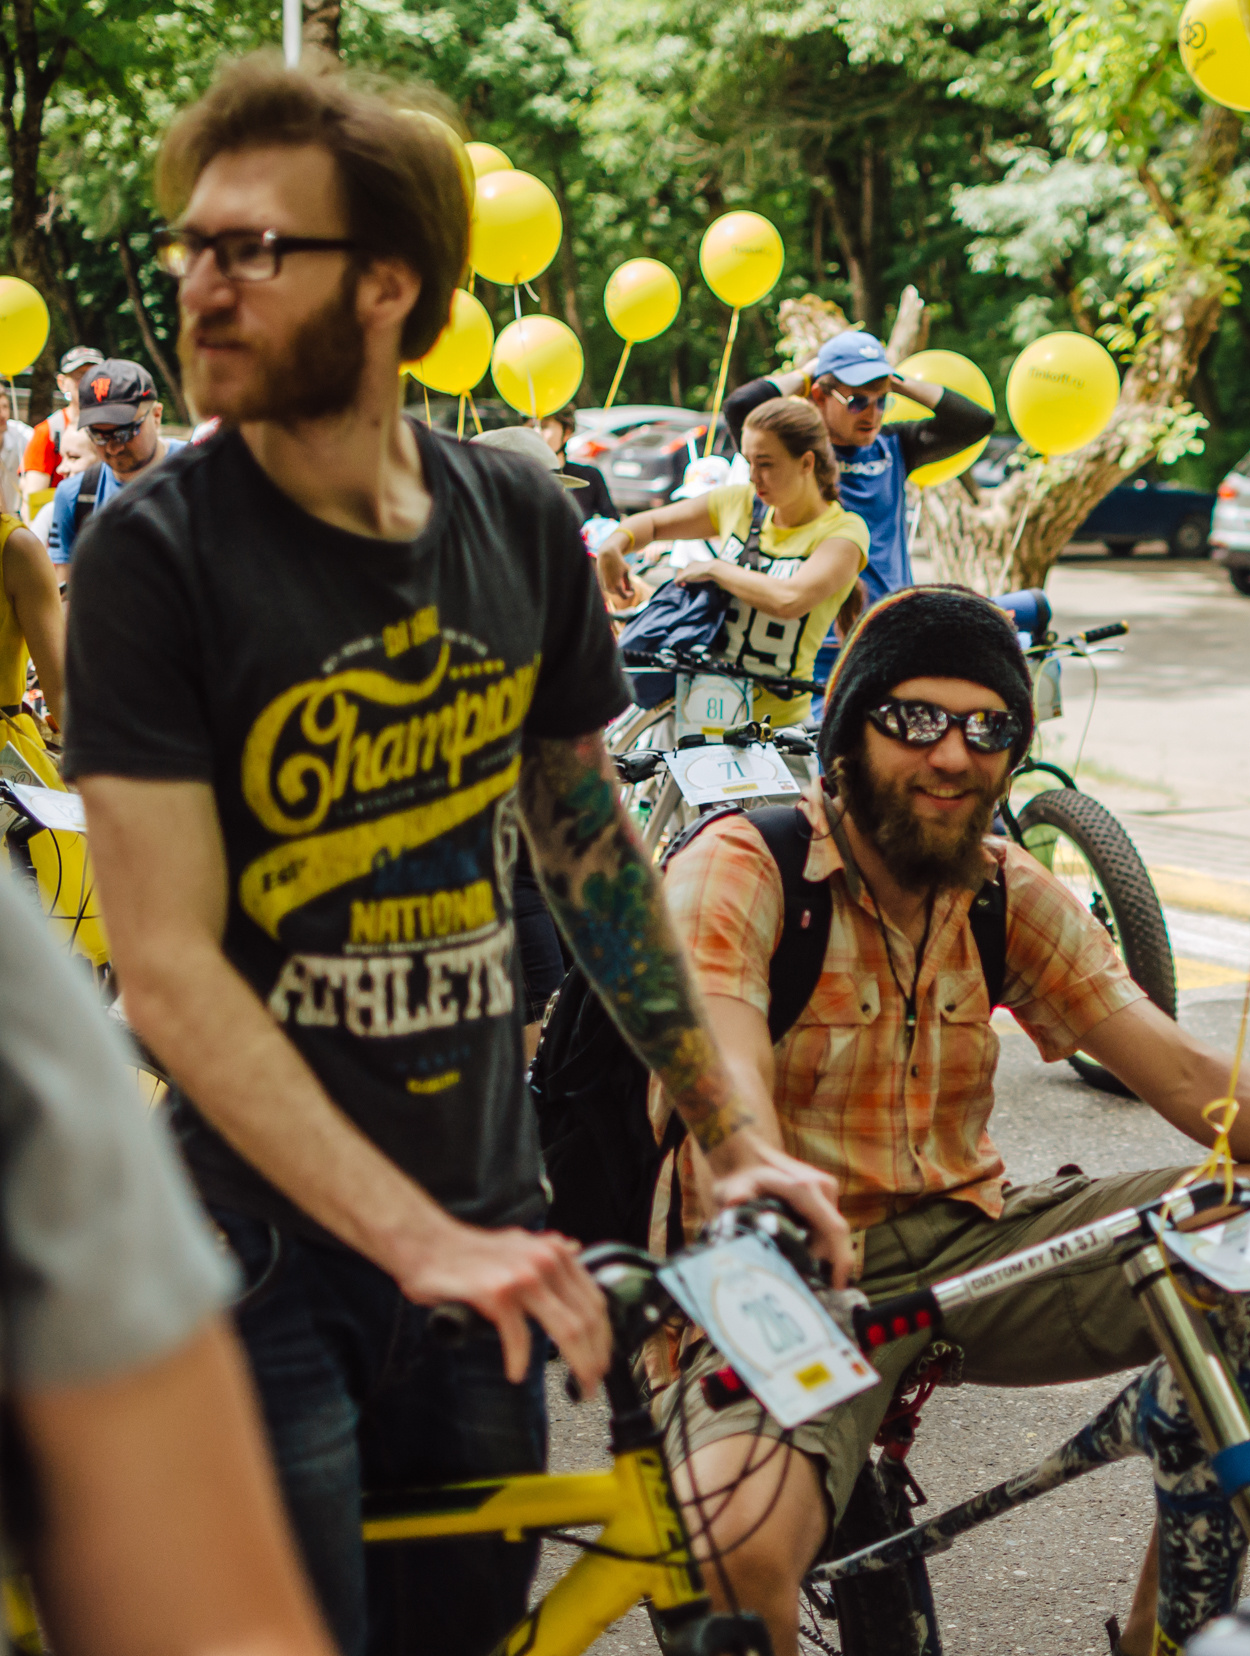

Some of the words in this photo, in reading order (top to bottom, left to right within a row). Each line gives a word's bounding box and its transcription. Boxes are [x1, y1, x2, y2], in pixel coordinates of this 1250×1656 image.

[706, 697, 724, 721] 81
[717, 760, 747, 780] 71
[970, 1262, 1025, 1291] CUSTOM
[1028, 1253, 1045, 1269] BY
